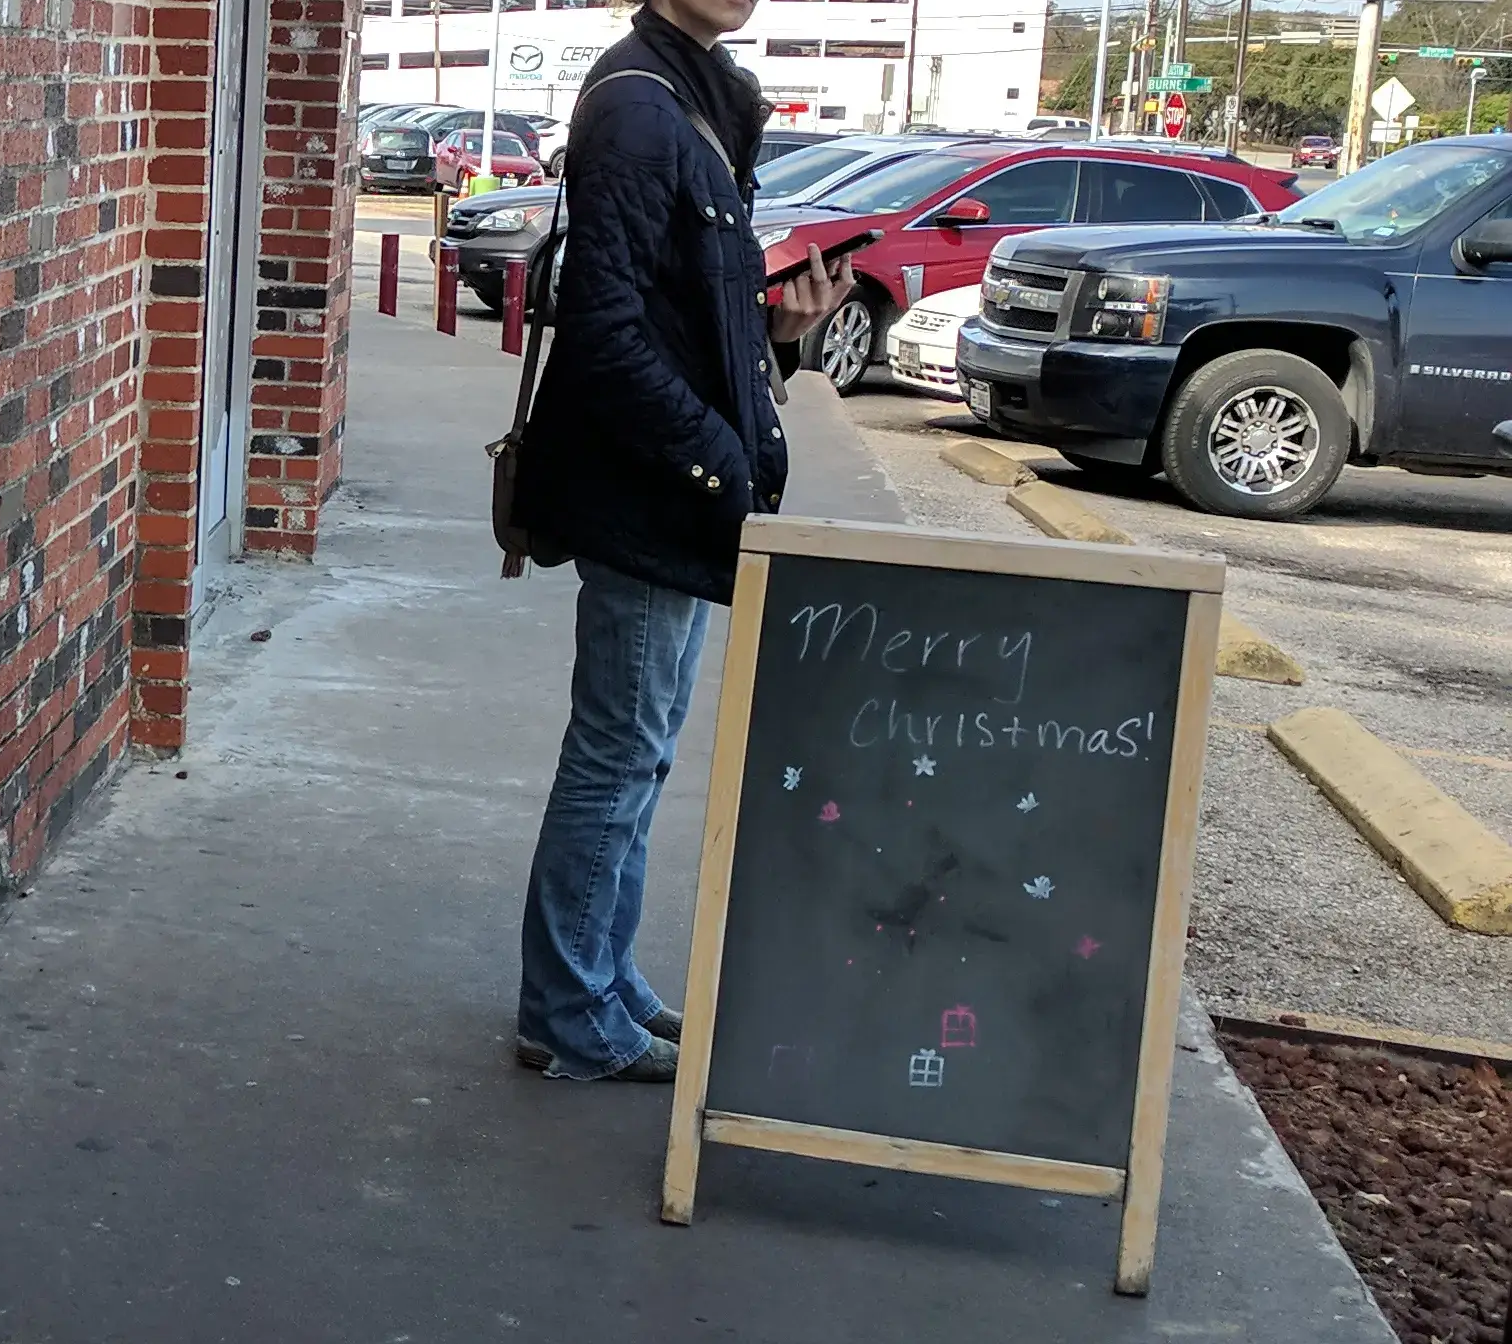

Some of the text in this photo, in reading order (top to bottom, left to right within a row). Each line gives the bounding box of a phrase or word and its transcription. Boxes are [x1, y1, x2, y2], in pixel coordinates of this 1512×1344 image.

[560, 46, 607, 62] CERT
[557, 69, 587, 82] Quali
[1148, 78, 1187, 91] BURNET
[1165, 106, 1184, 125] STOP
[1422, 365, 1512, 381] SILVERAD
[790, 602, 1033, 704] Merry
[849, 697, 1156, 762] Christmas!
